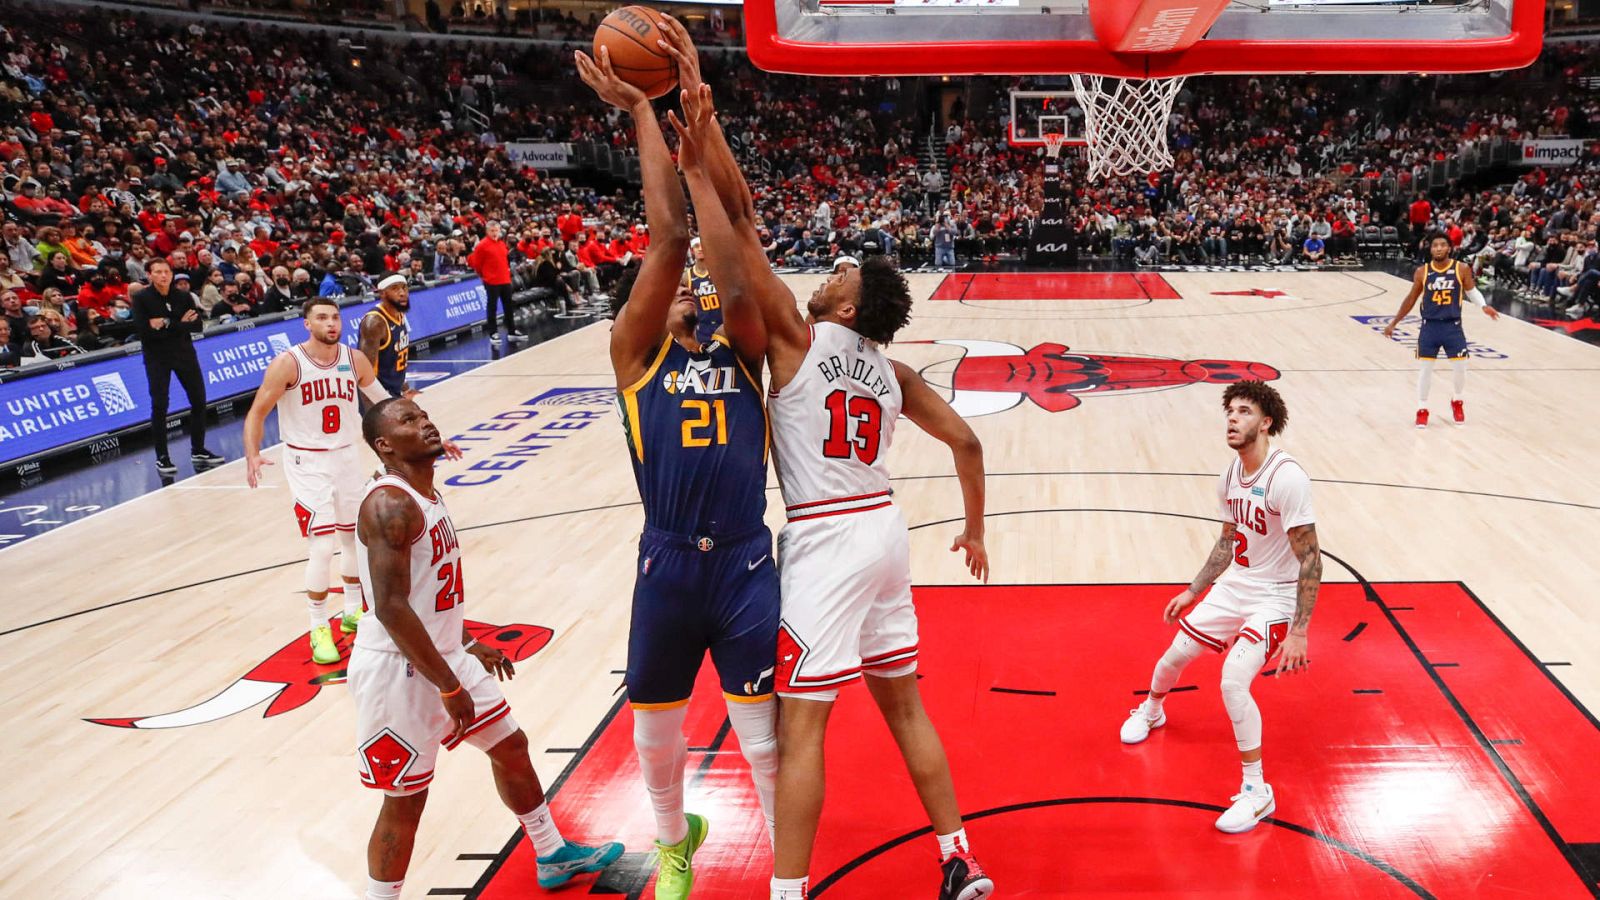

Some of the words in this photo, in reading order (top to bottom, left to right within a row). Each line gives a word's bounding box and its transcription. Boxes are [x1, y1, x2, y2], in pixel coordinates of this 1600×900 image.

[522, 150, 564, 161] Advocate
[1535, 143, 1580, 160] impact
[445, 301, 481, 319] AIRLINES
[447, 290, 476, 305] UNITED
[700, 294, 720, 311] 00
[1432, 290, 1452, 305] 45
[212, 341, 268, 365] UNITED
[300, 377, 355, 406] BULLS
[663, 357, 741, 395] JAZZ
[6, 384, 91, 416] UNITED
[0, 401, 100, 441] AIRLINES
[322, 404, 340, 434] 8
[680, 399, 728, 448] 21
[823, 388, 882, 466] 13
[444, 410, 610, 486] CENTER
[429, 515, 460, 567] BULL
[1233, 529, 1250, 568] 2
[435, 556, 465, 612] 24
